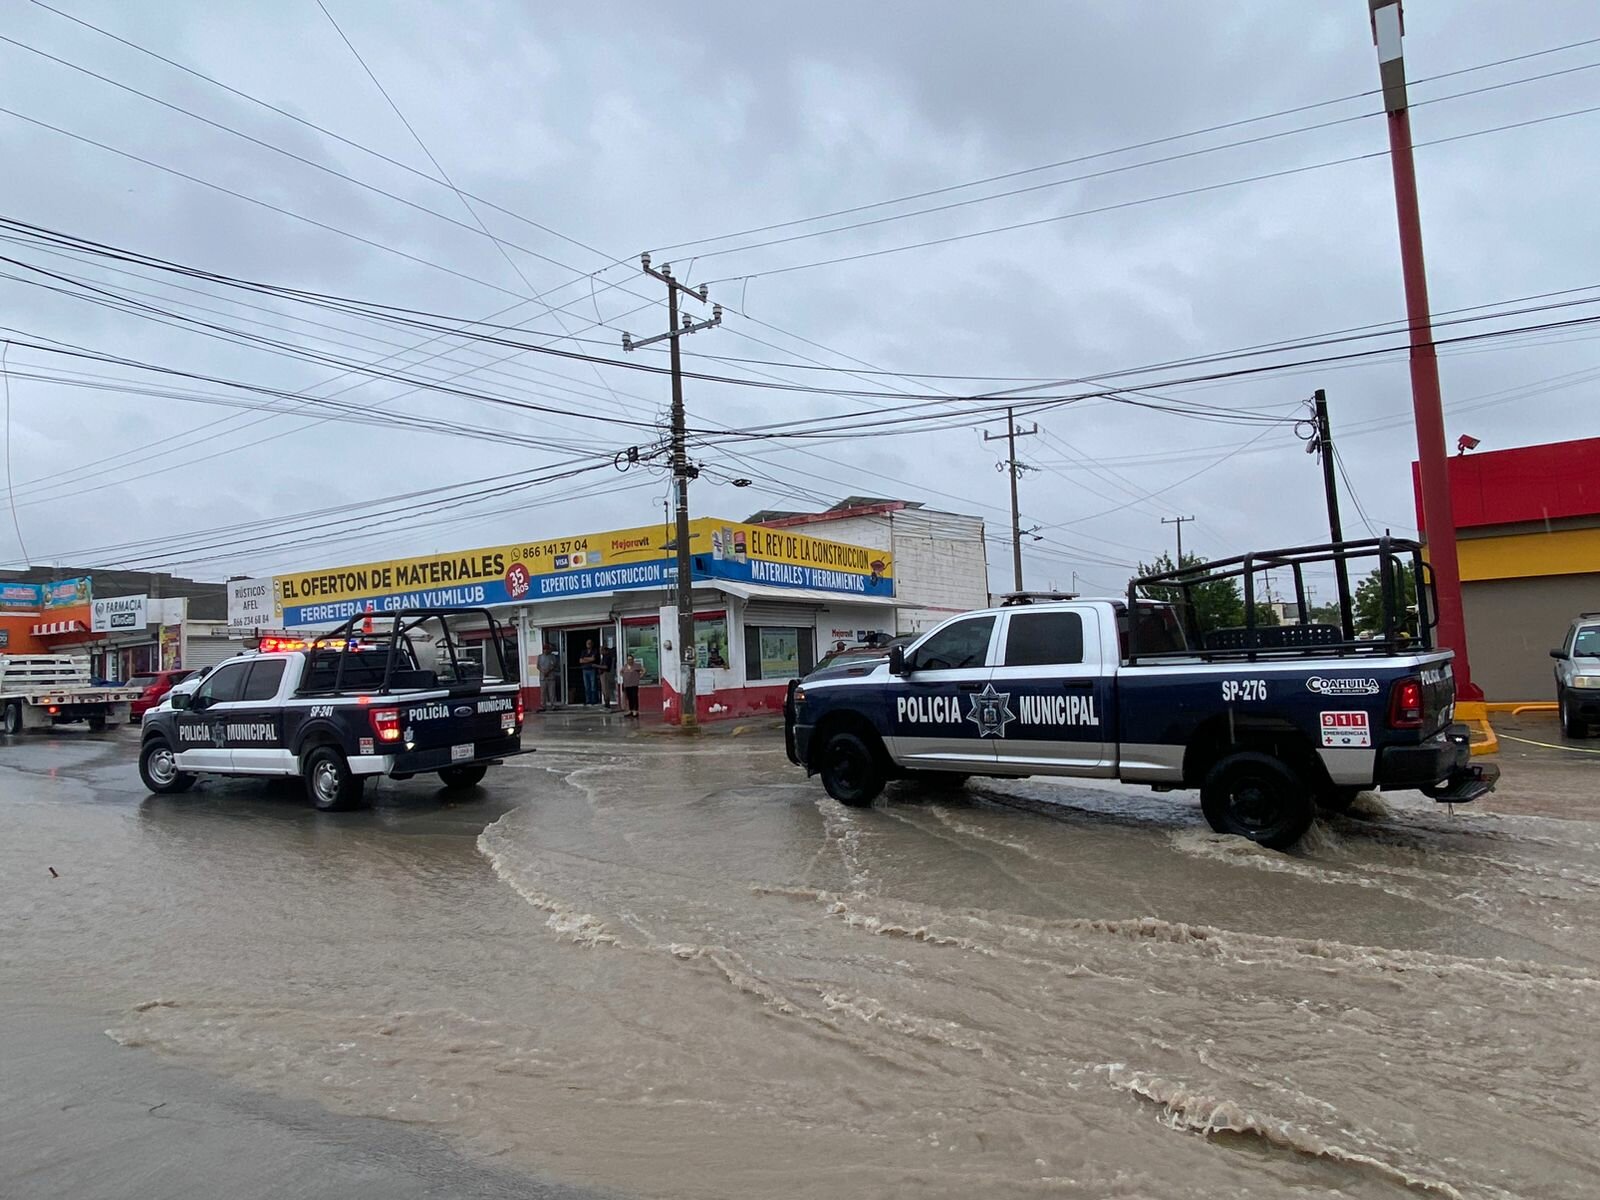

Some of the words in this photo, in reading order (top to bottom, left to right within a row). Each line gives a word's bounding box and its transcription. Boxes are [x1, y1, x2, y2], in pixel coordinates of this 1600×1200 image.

[523, 546, 541, 559] 866
[543, 543, 558, 556] 141
[560, 541, 572, 554] 37
[574, 538, 588, 551] 04
[611, 536, 650, 549] Mejoravit
[752, 530, 763, 555] EL
[766, 533, 783, 558] REY
[787, 537, 798, 560] DE
[801, 539, 811, 561] LA
[812, 541, 869, 570] CONSTRUCCION
[555, 558, 569, 567] VISA
[282, 581, 299, 599] EL
[301, 571, 368, 596] OFERTON
[371, 568, 392, 588] DE
[396, 553, 505, 587] MATERIALES
[509, 567, 525, 588] 35
[541, 575, 580, 594] EXPERTOS
[581, 573, 593, 590] EN
[594, 565, 661, 587] CONSTRUCCION
[751, 560, 803, 585] MATERIALES
[805, 568, 811, 585] Y
[812, 569, 865, 591] HERRAMIENTAS
[511, 584, 530, 599] AÑOS
[106, 599, 143, 613] FARMACIA
[243, 599, 259, 610] AFEL
[300, 602, 364, 622] FERRETERA
[383, 592, 421, 612] GRAN
[424, 586, 485, 608] VUMILUB
[1222, 680, 1267, 701] SP-276
[1305, 676, 1380, 693] COAHUILA
[408, 703, 450, 722] POLICÍA
[477, 698, 513, 714] MUNICIPAL
[1019, 695, 1099, 726] MUNICIPAL
[1324, 715, 1365, 726] 911
[179, 722, 210, 741] POLICÍA
[226, 723, 278, 741] MUNICIPAL
